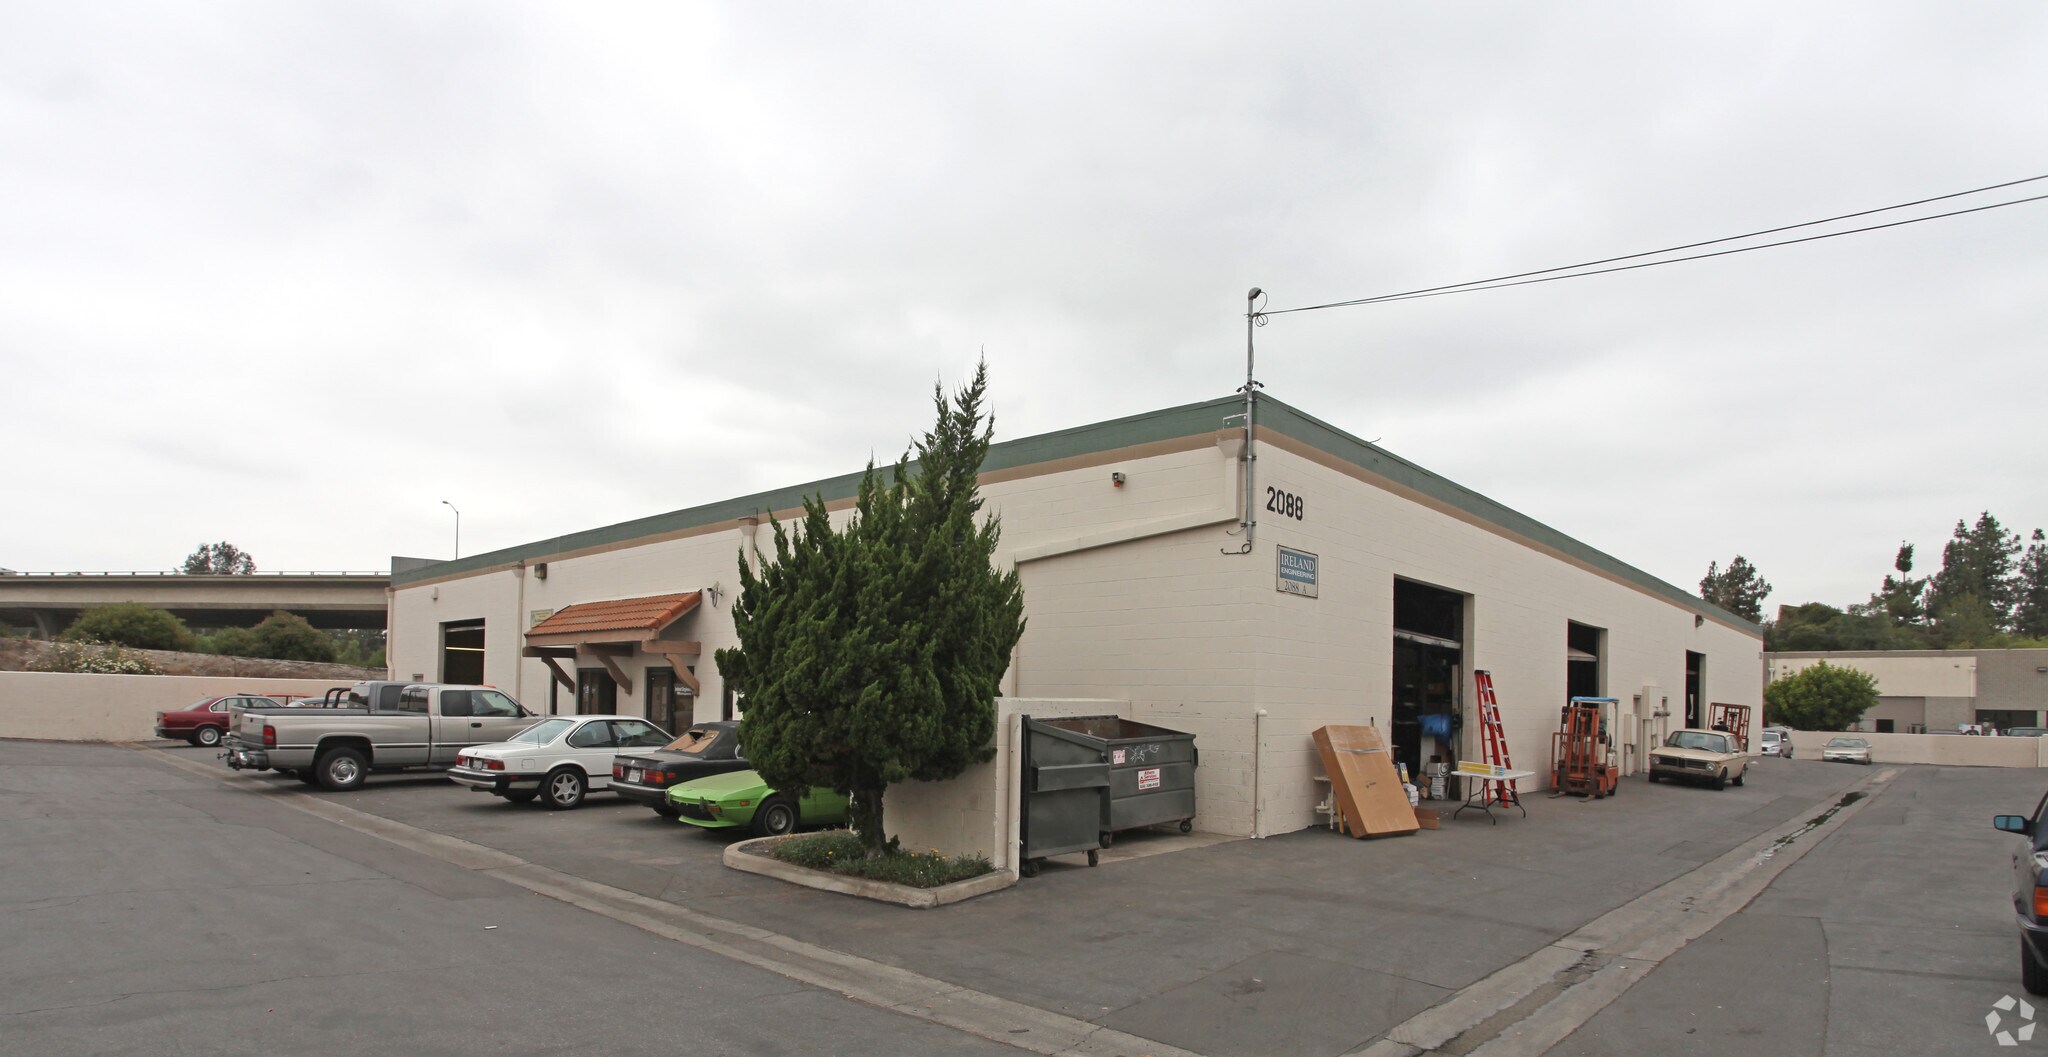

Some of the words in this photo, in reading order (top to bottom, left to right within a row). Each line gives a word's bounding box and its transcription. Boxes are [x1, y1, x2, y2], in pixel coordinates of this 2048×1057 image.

[1266, 486, 1303, 521] 2088
[1281, 553, 1314, 571] IRELAND
[1281, 567, 1314, 579] ENGINEERING
[1284, 580, 1300, 593] 2088
